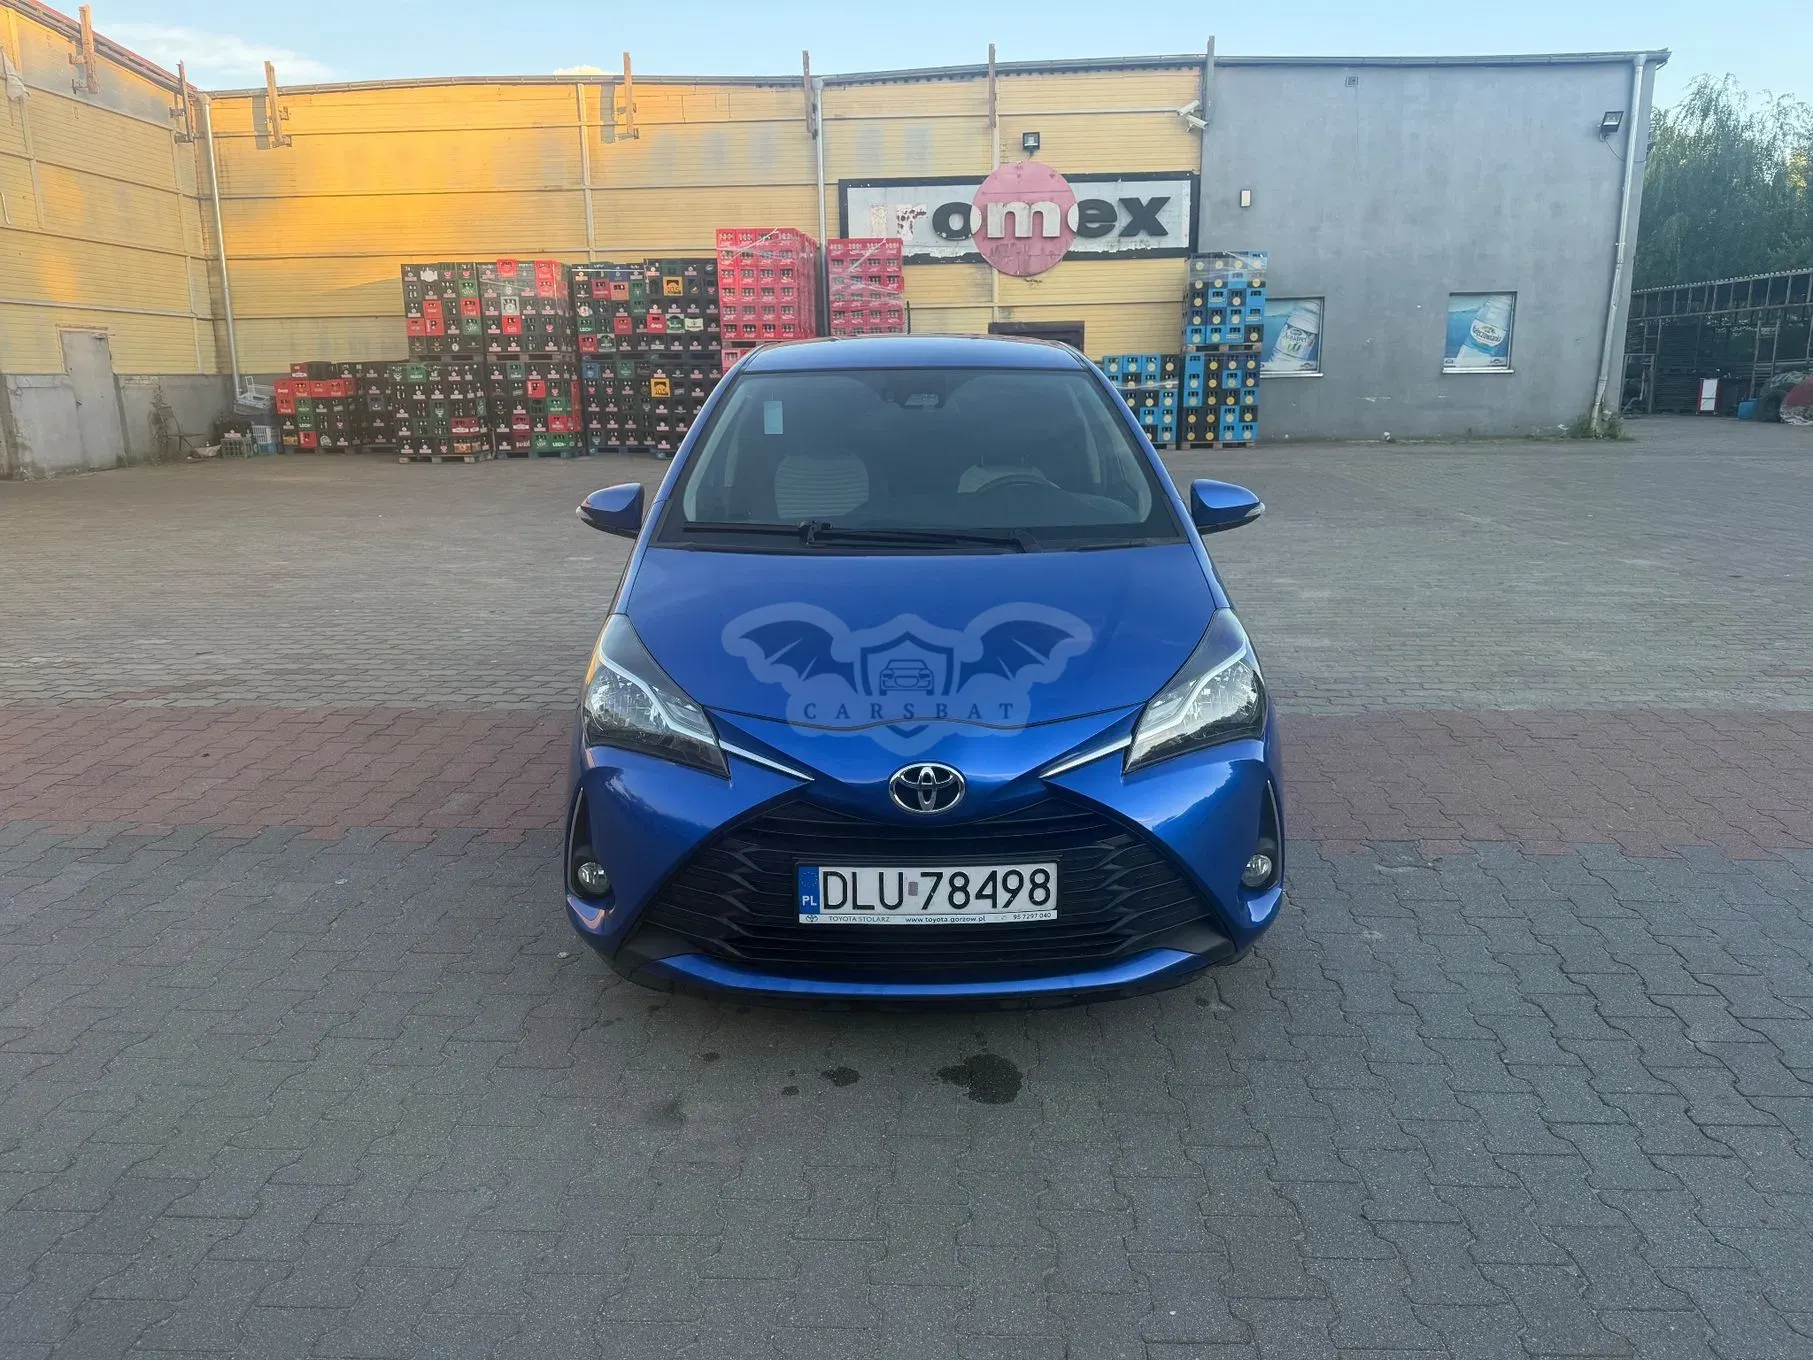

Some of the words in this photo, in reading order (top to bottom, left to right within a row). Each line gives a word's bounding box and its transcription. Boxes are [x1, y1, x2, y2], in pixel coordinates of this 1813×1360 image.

[802, 895, 817, 906] PL
[822, 870, 904, 911] DLU
[920, 868, 1051, 910] 78498
